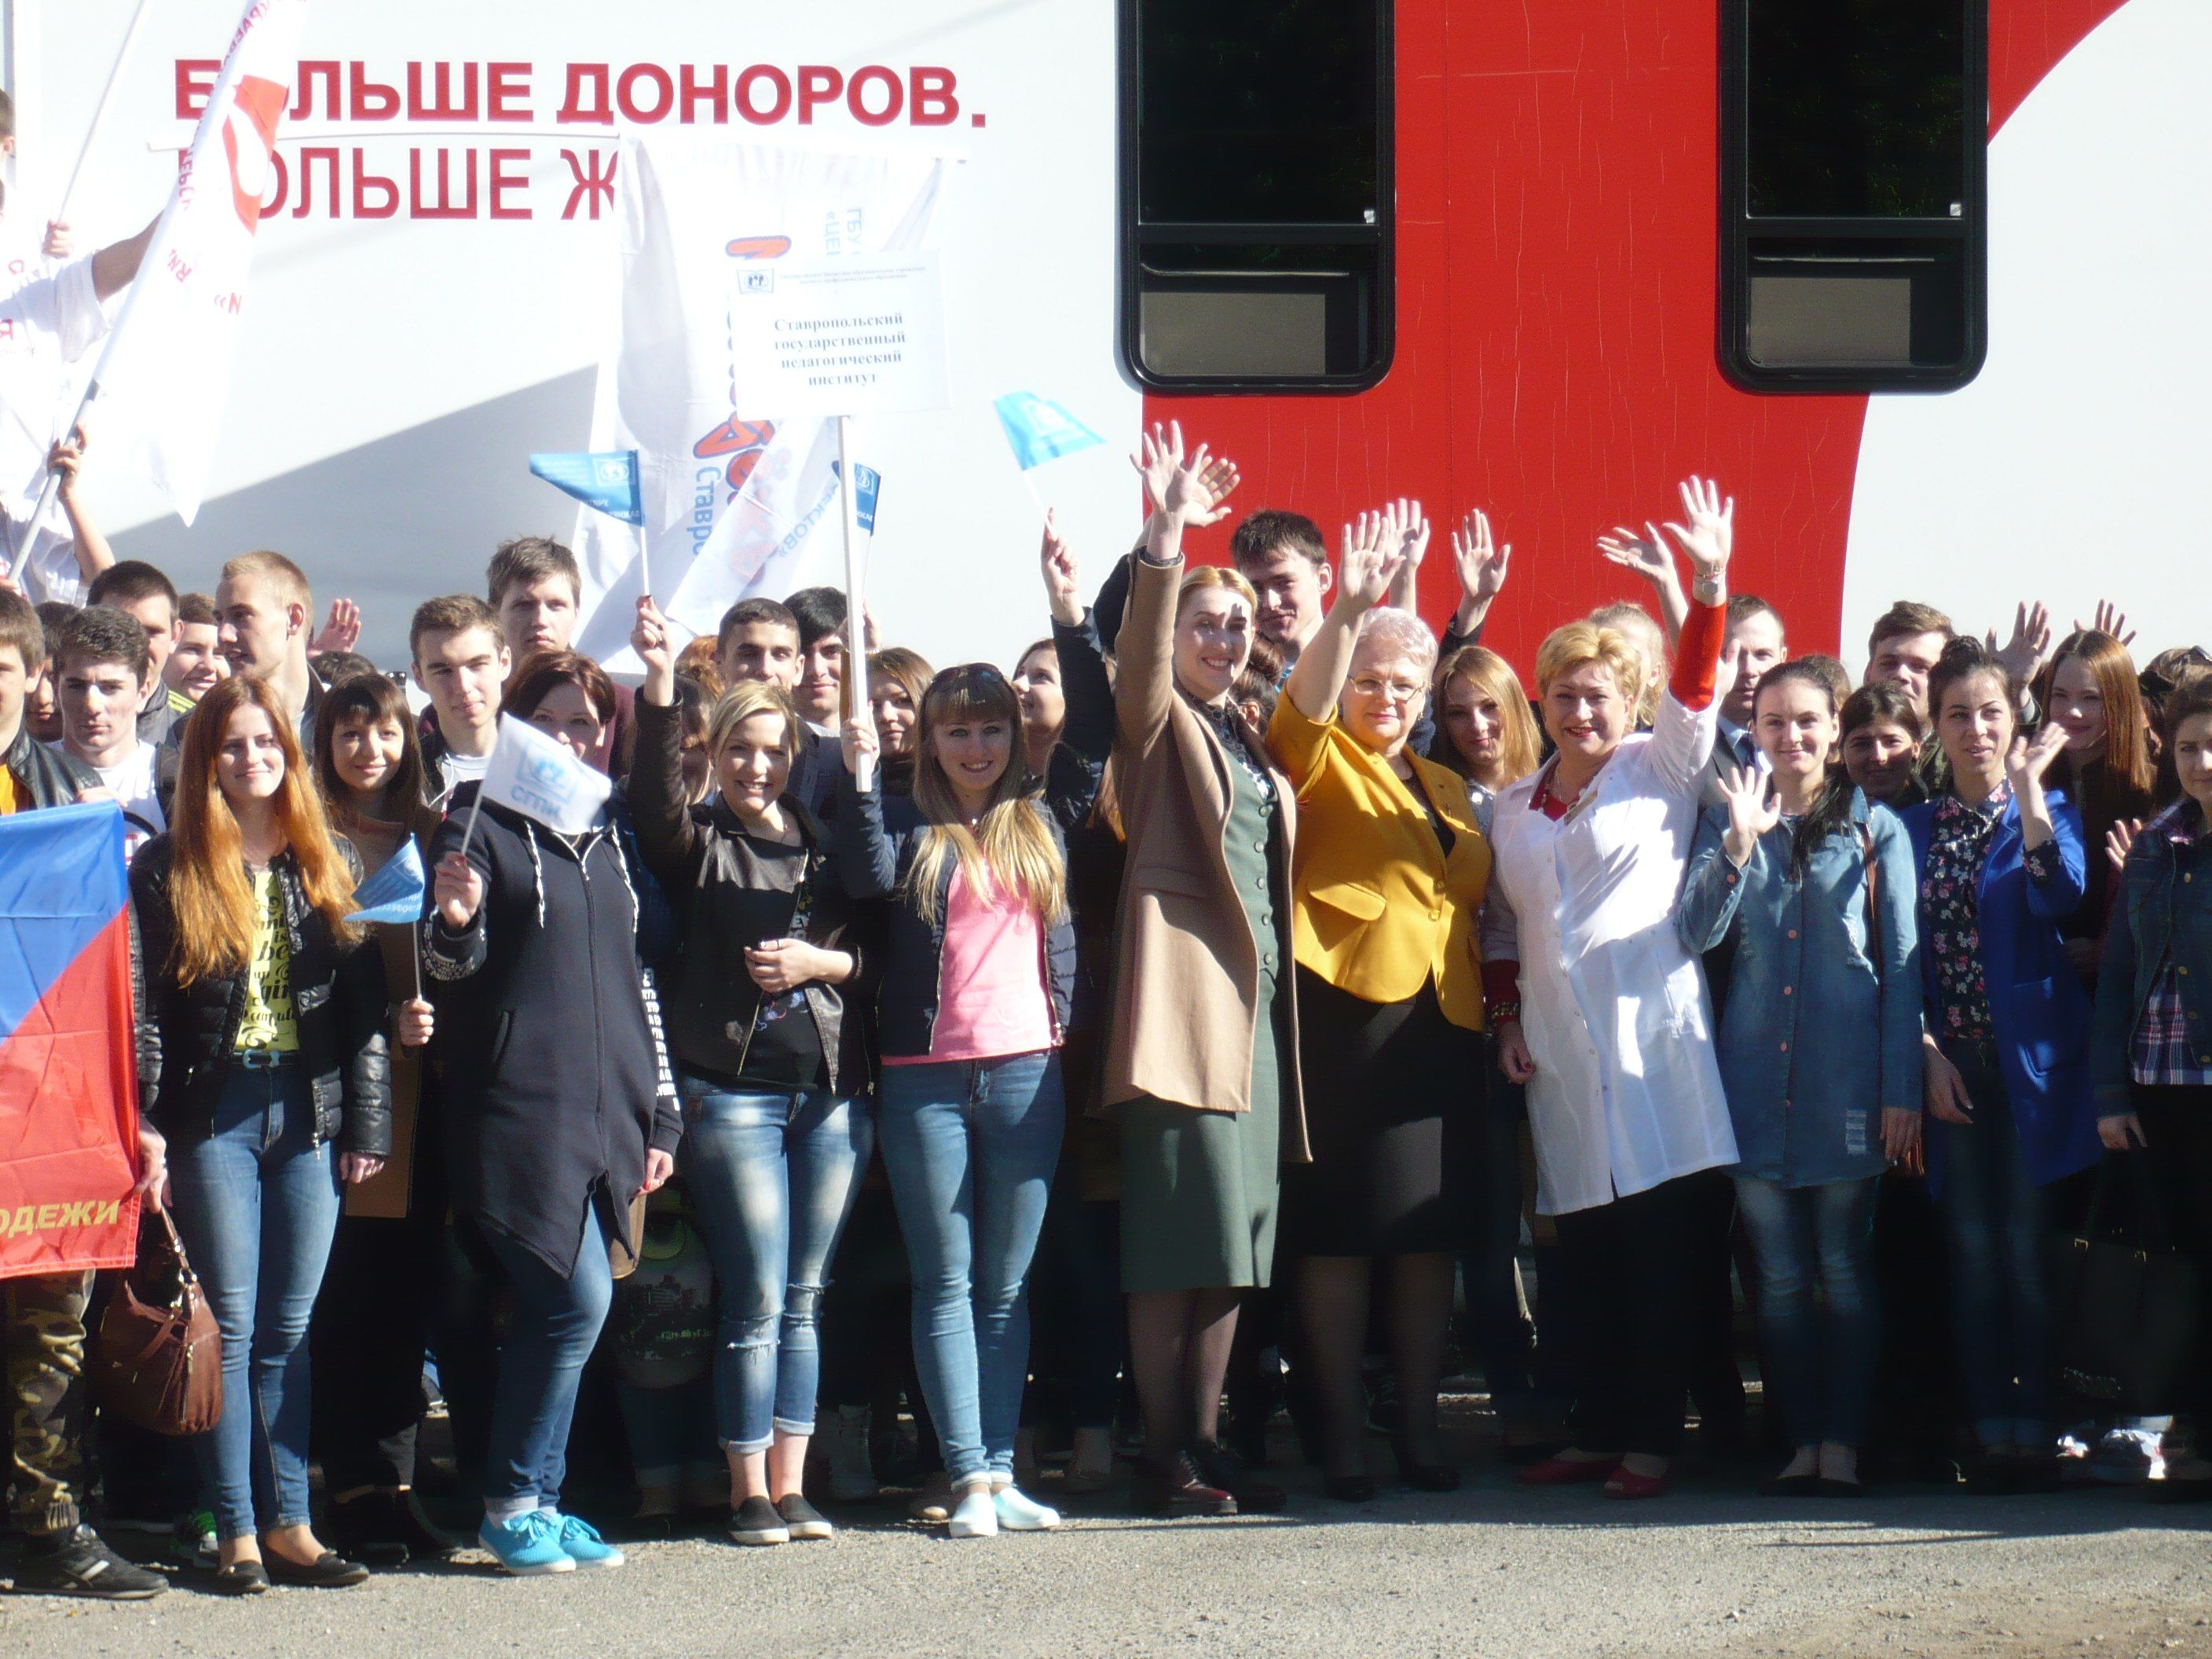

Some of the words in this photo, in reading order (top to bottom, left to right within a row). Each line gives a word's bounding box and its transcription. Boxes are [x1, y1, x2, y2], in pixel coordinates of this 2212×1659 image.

[174, 59, 534, 123] БЛЬШЕ
[556, 63, 987, 128] ДОНОРОВ.
[178, 148, 533, 220] ЛЬШЕ
[774, 311, 903, 332] Ставропольский
[774, 331, 906, 352] государственный
[782, 350, 903, 368] педагогический
[808, 372, 877, 386] институт
